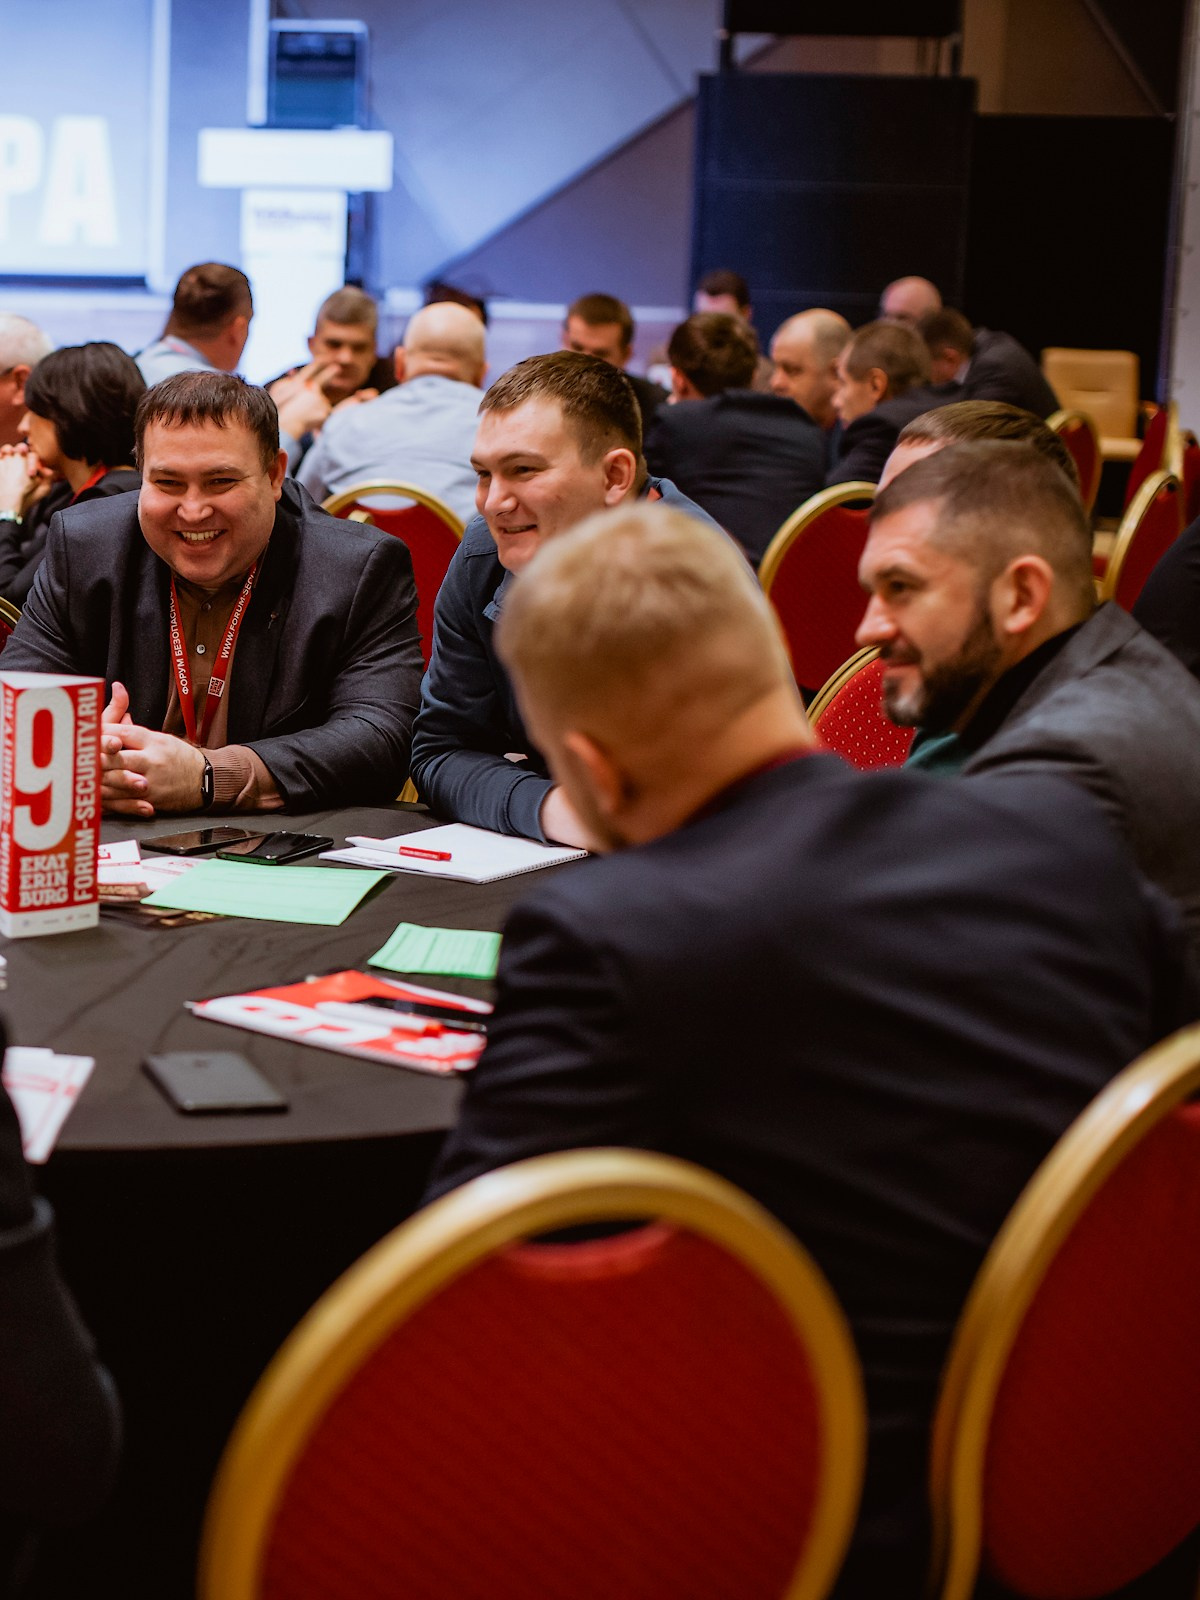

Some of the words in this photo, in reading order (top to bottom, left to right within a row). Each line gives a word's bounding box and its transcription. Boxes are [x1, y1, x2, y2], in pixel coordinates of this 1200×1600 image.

[176, 658, 188, 694] ФОРУМ
[14, 687, 75, 851] 9
[73, 687, 98, 901] FORUM-SECURITY.RU
[20, 853, 70, 872] EKAT
[19, 869, 69, 890] ERIN
[18, 887, 68, 908] BURG
